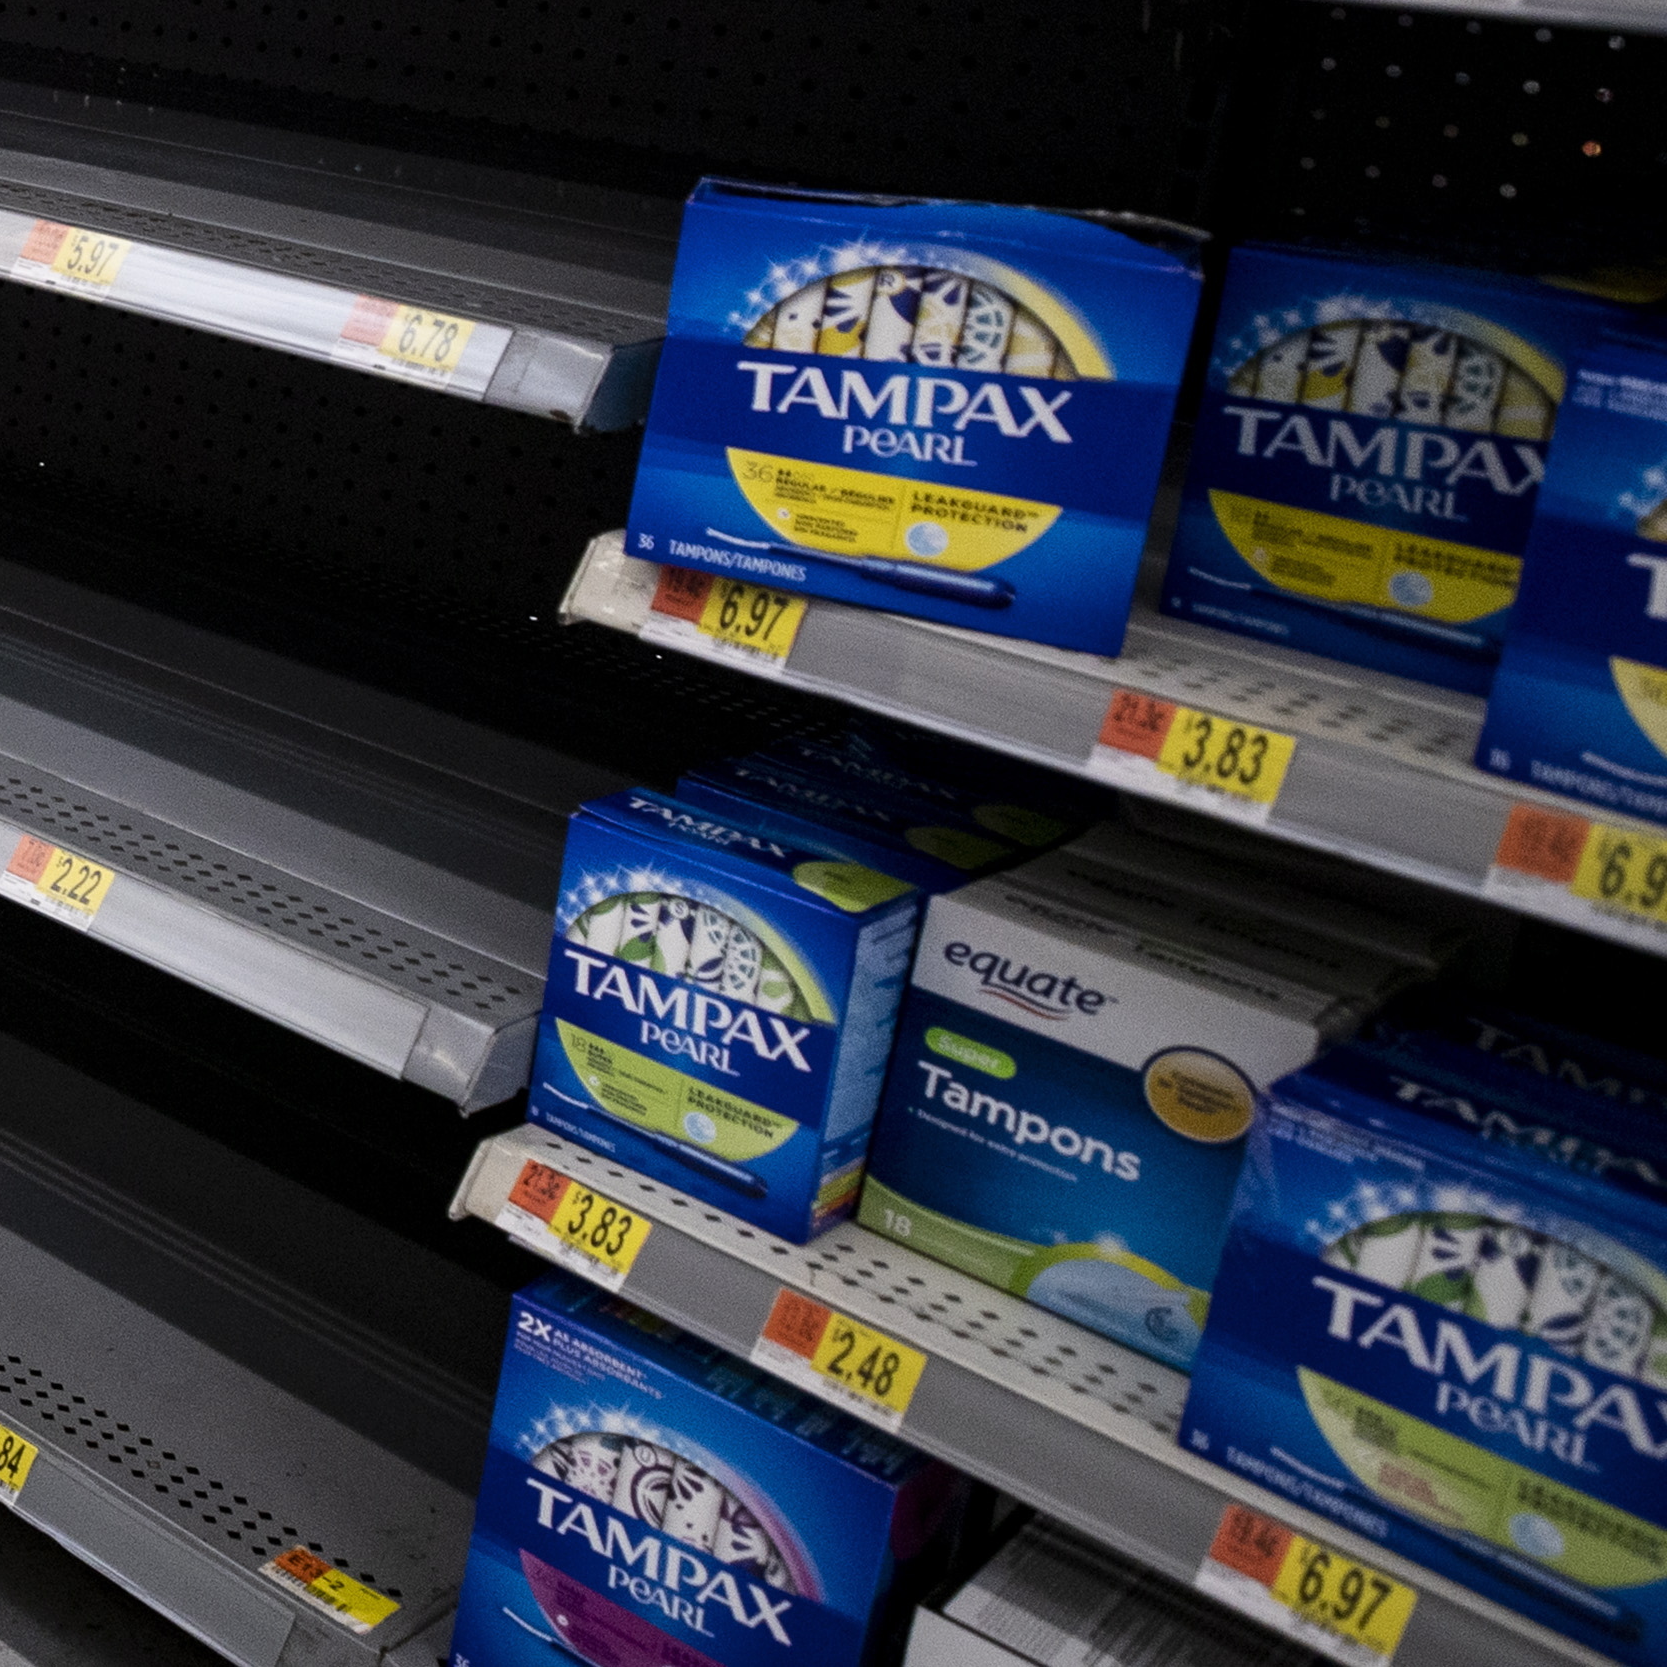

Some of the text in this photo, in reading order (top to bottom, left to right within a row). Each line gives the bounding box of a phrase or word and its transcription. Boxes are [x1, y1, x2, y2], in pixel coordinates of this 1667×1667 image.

[736, 360, 1074, 444] TAMPAX
[1222, 405, 1549, 497] TAMPAX
[638, 533, 807, 582] 36 TAMPONS/TAMPONES
[627, 796, 787, 859] TAMPAX
[562, 947, 813, 1074] TAMPAX
[942, 940, 1107, 1017] equate
[918, 1059, 1142, 1182] Tampons
[883, 1207, 912, 1238] 18
[517, 1310, 552, 1342] 2X
[1312, 1274, 1667, 1460] TAMPA
[525, 1476, 793, 1647] TAMPAX
